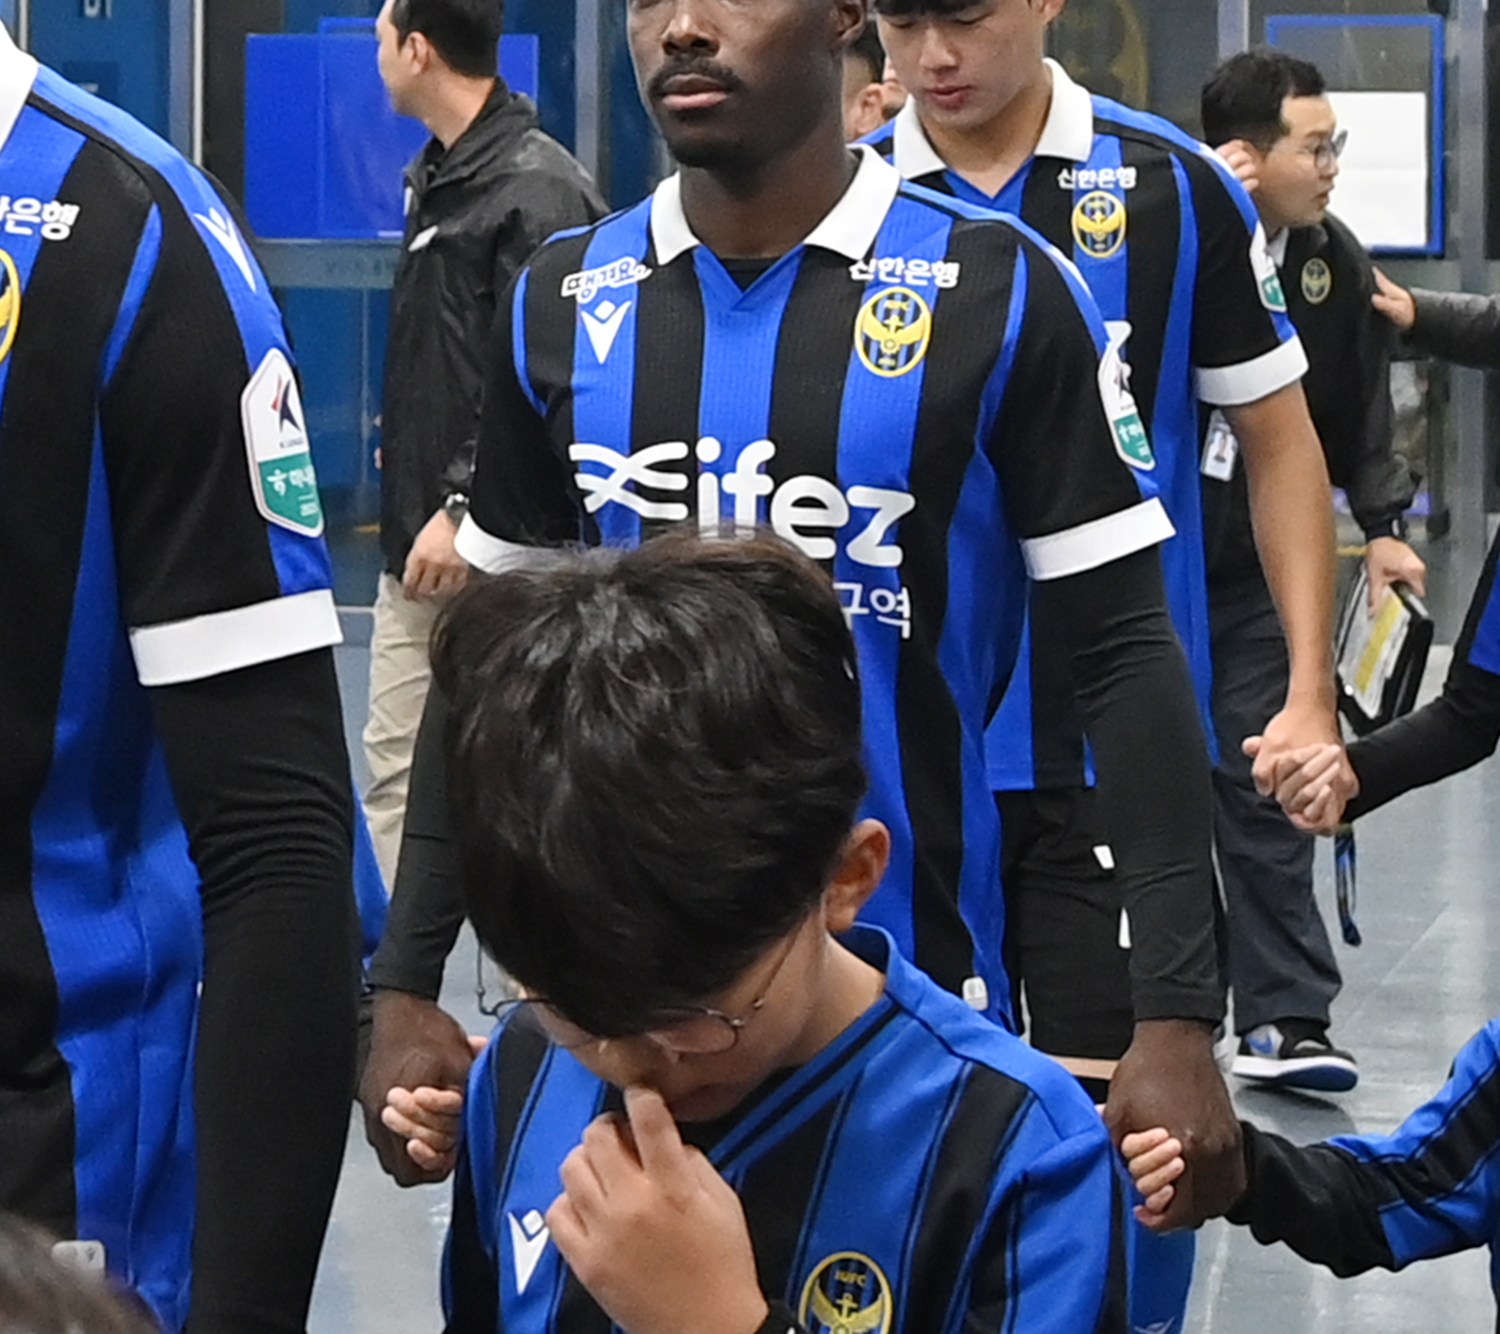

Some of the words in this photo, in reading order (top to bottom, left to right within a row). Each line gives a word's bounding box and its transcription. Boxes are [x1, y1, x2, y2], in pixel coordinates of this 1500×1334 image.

[1057, 166, 1137, 189] 신한은행
[848, 256, 961, 289] 신한은행
[696, 437, 916, 569] ifez
